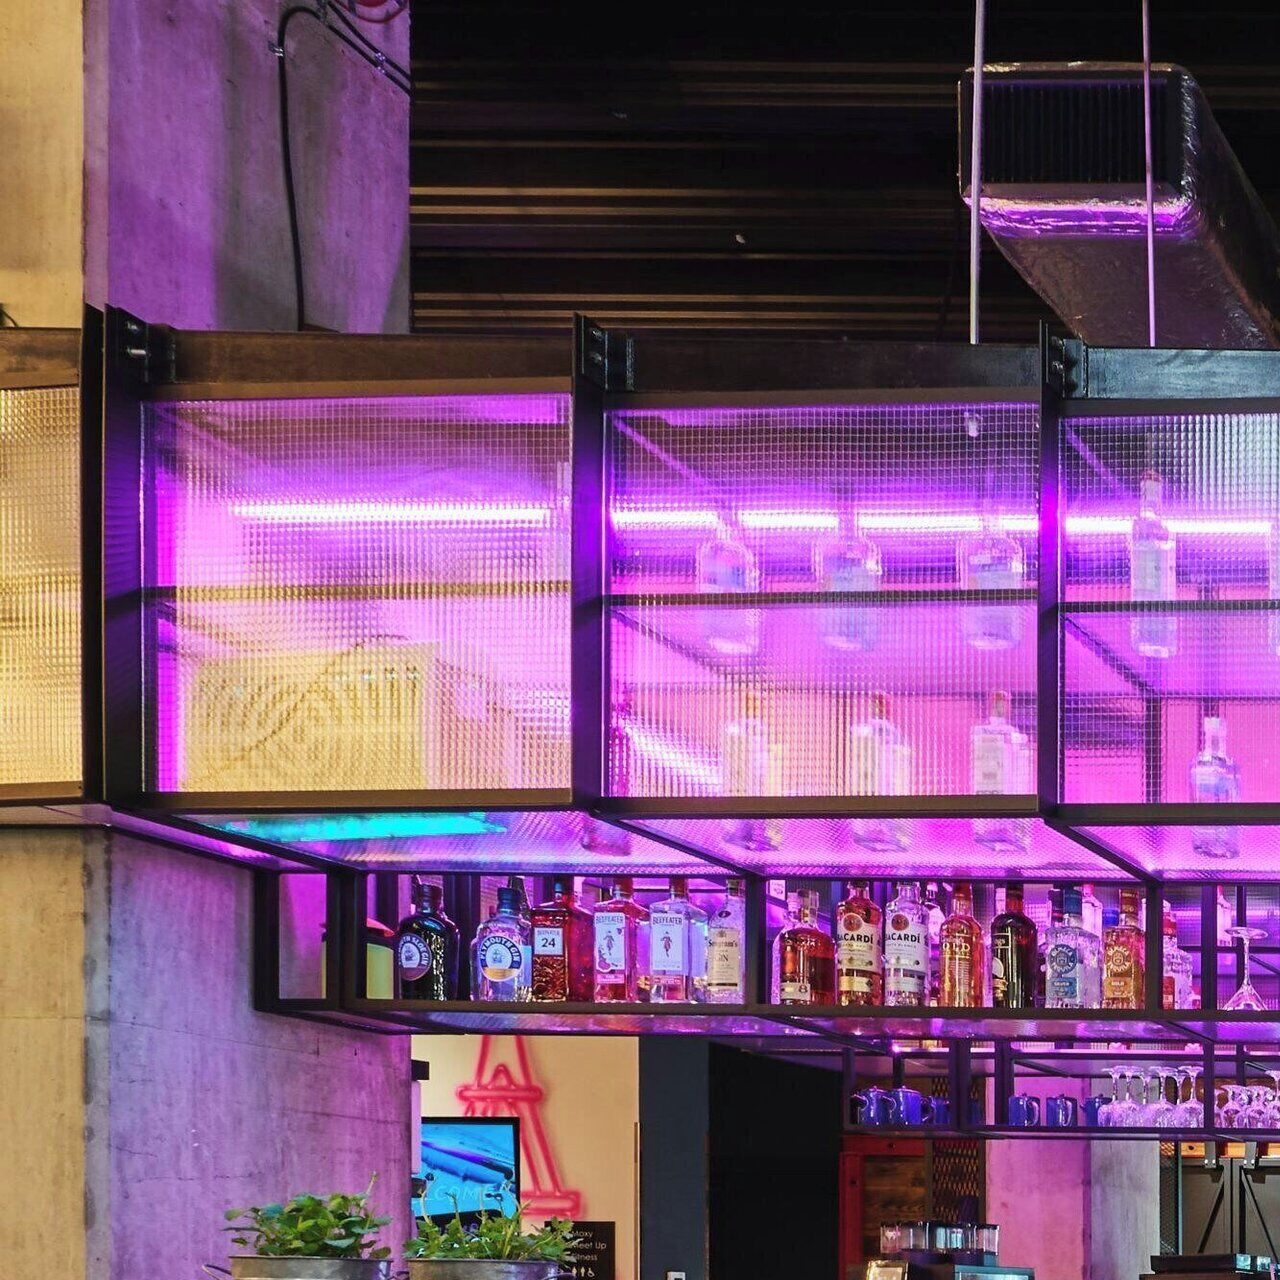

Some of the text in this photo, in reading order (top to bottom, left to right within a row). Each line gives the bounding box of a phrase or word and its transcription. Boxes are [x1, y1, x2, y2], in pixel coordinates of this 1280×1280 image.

[541, 937, 556, 948] 24
[838, 932, 874, 944] ACARDÍ
[595, 1240, 607, 1251] Up
[573, 1252, 598, 1262] itness
